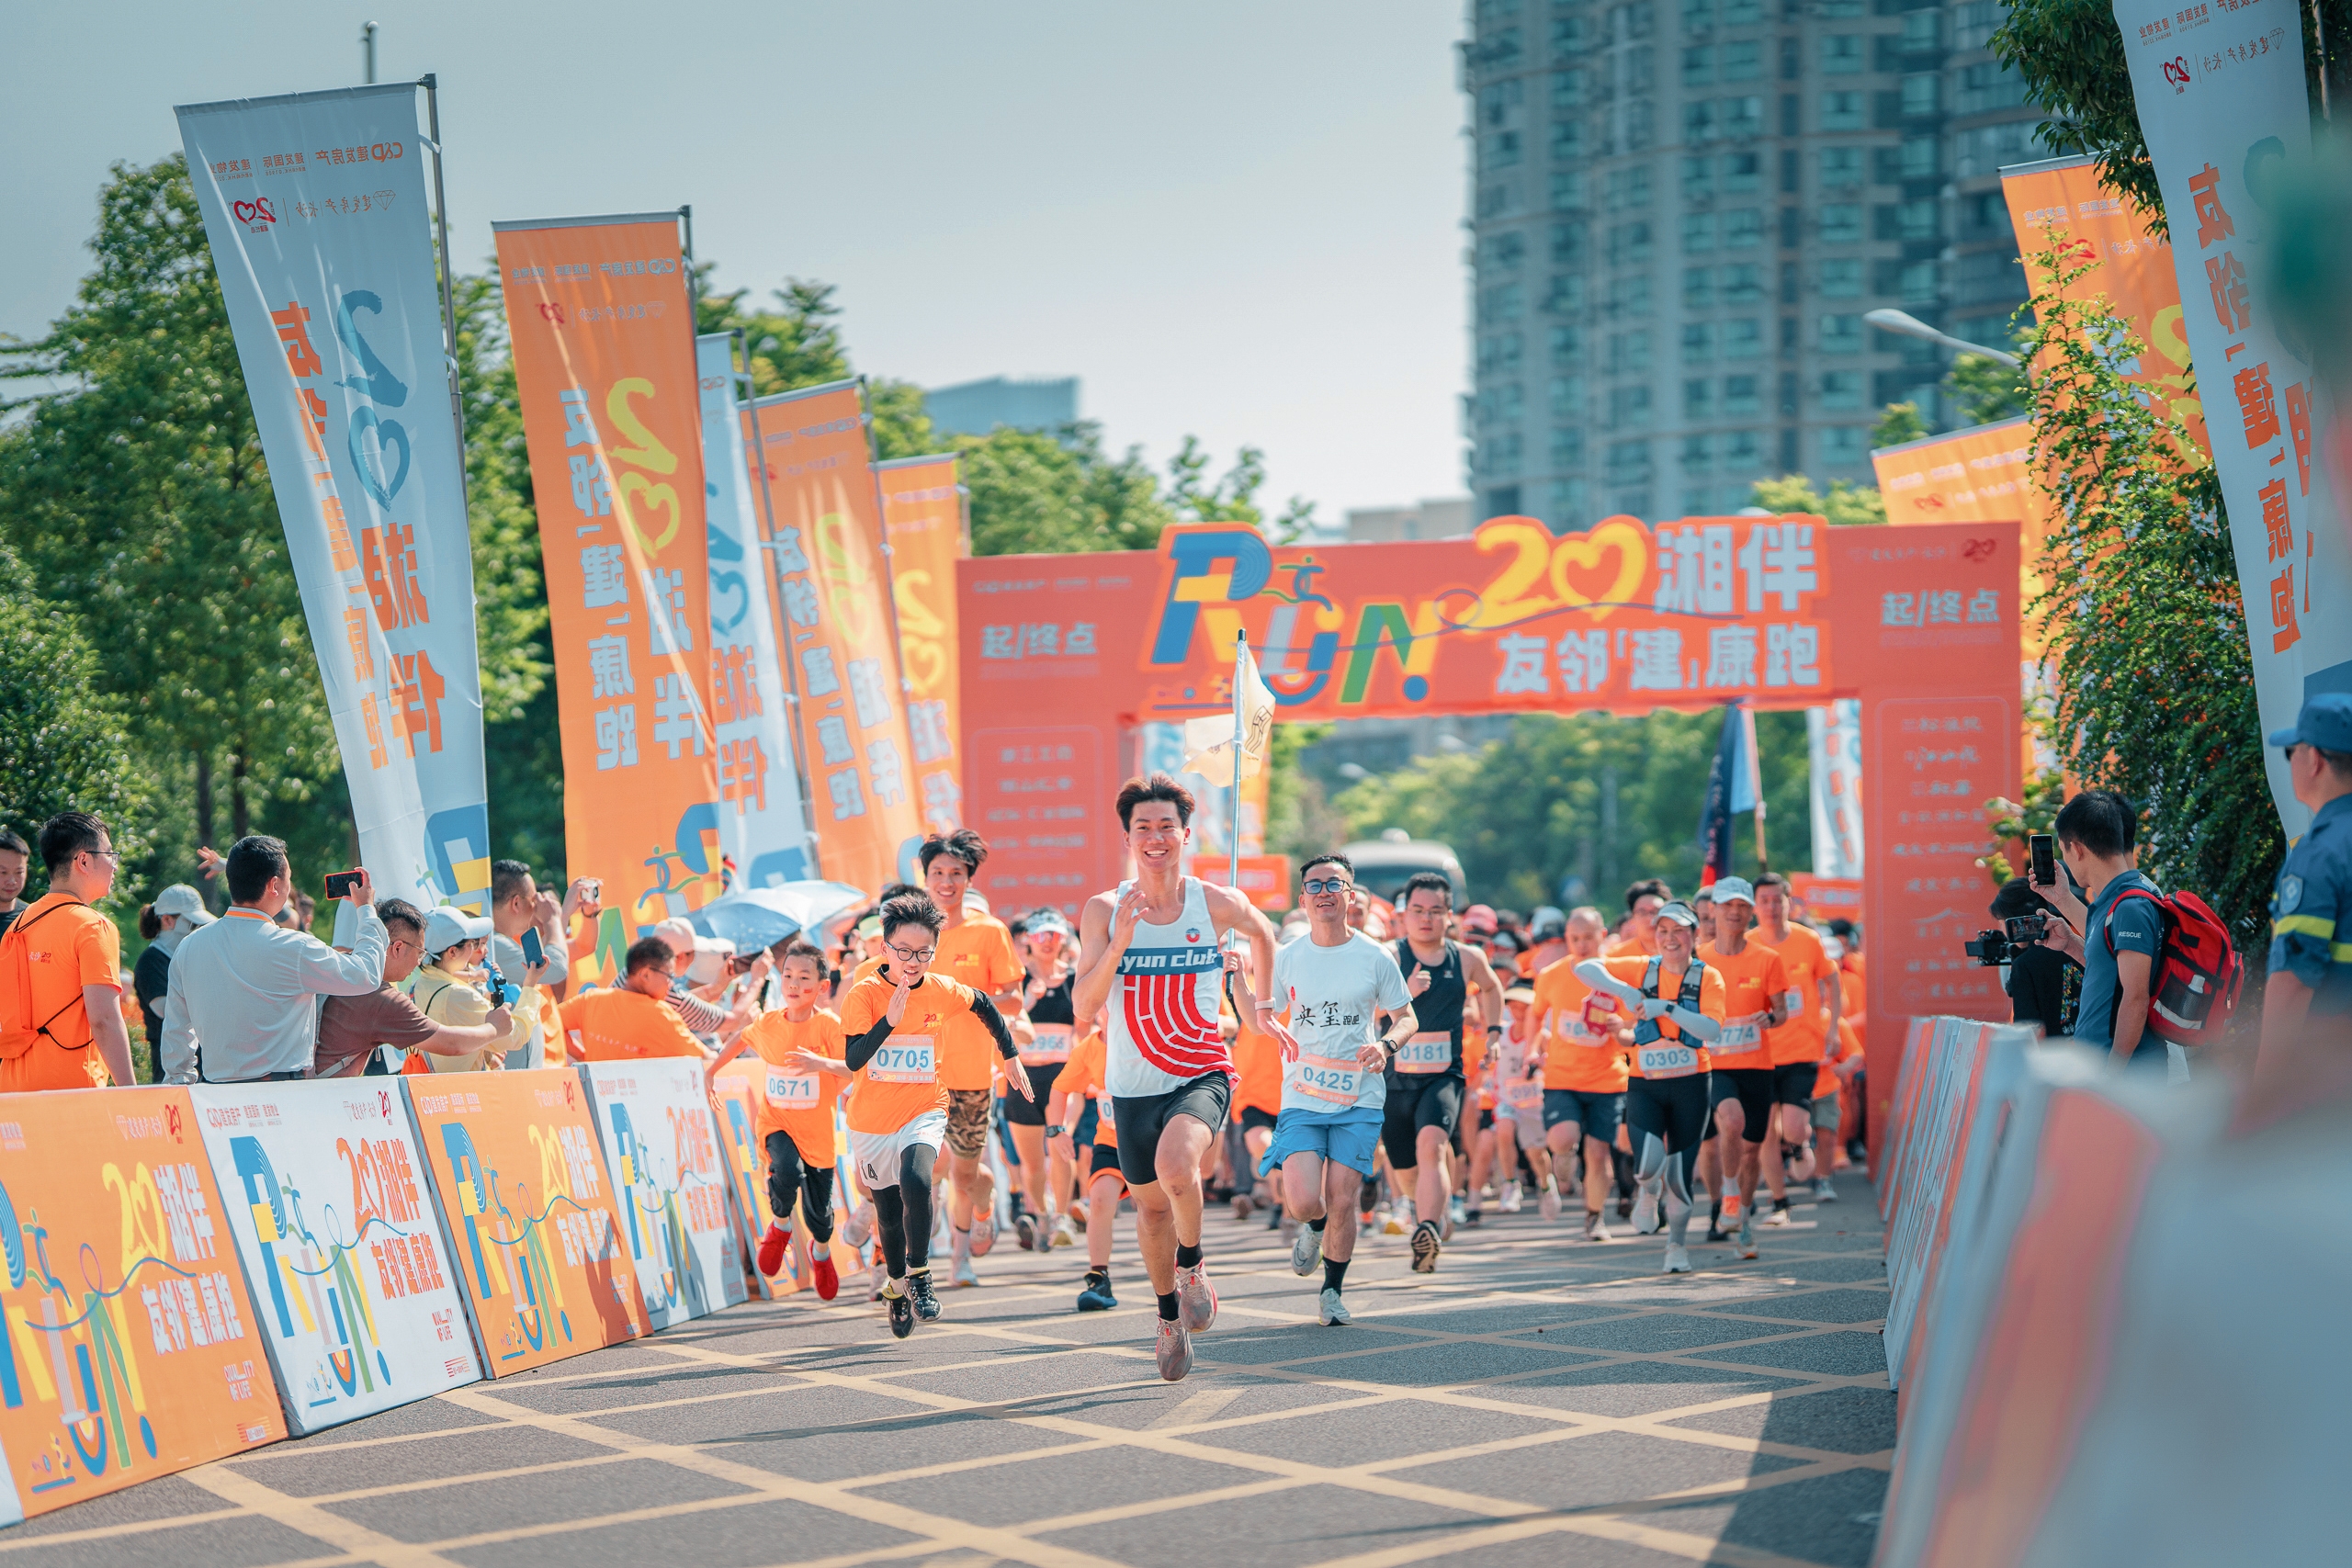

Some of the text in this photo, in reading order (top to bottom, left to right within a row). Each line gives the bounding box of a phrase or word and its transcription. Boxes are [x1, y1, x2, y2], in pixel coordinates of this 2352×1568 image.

[1654, 523, 1818, 615] 湘伴
[1882, 588, 2000, 628] 起/终点
[981, 621, 1098, 660] 起/终点
[2118, 931, 2142, 939] RESCUE
[1118, 948, 1218, 973] yun club
[876, 1048, 930, 1068] 0705
[1400, 1044, 1445, 1061] 0181
[1645, 1048, 1691, 1067] 0303
[769, 1077, 809, 1097] 0671
[1303, 1066, 1354, 1091] 0425
[153, 1162, 217, 1263] 湘伴
